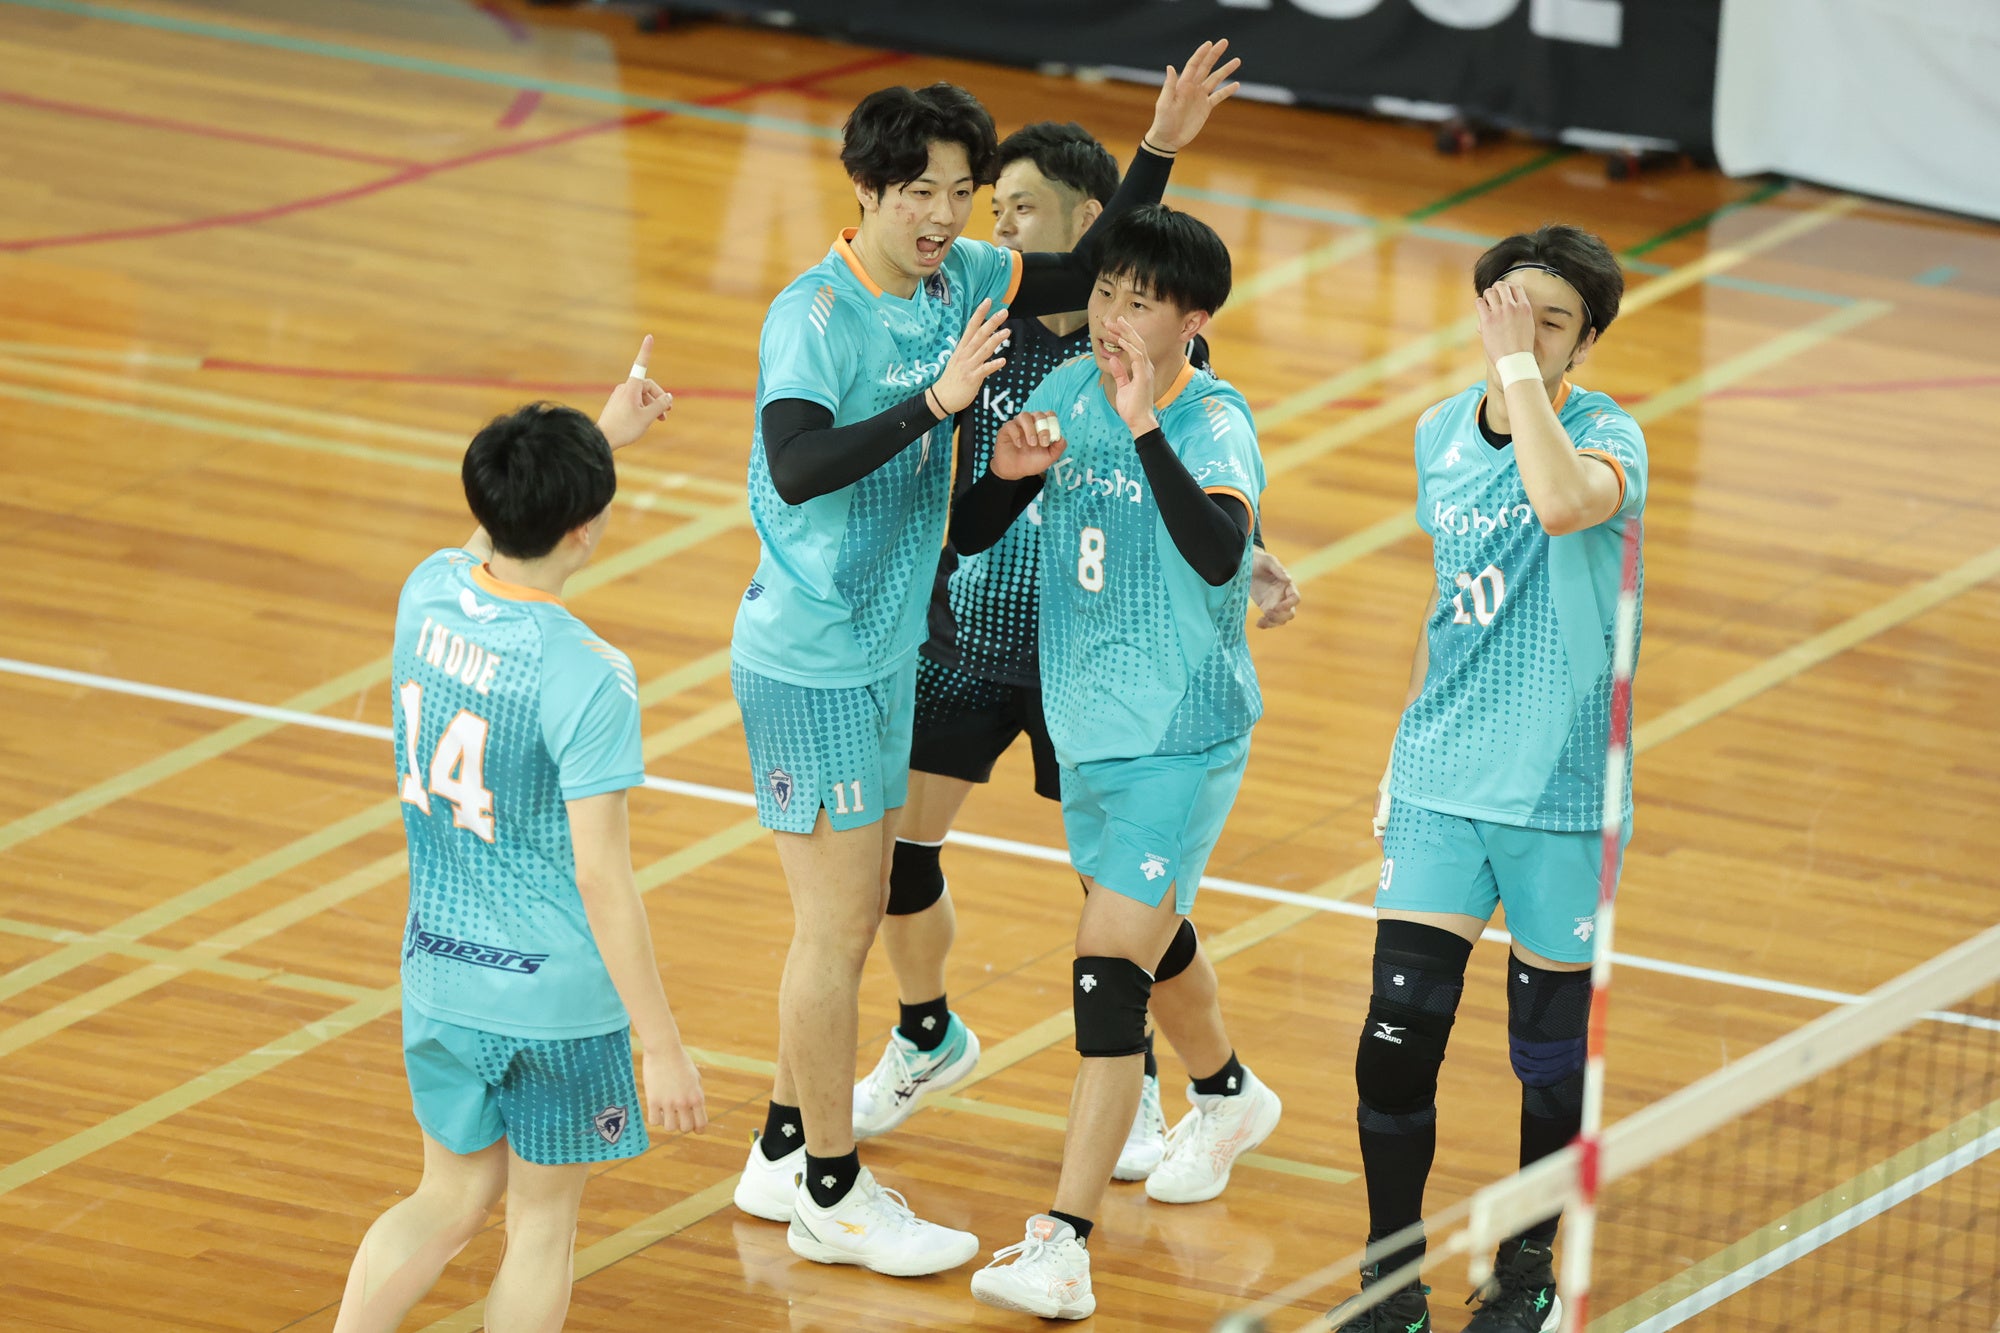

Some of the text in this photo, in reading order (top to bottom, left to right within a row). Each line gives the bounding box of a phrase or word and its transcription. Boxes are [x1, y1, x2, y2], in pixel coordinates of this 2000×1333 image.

[1434, 501, 1532, 538] Kubta
[1077, 525, 1106, 593] 8
[1452, 564, 1505, 627] 10
[414, 615, 501, 696] INOUE
[399, 677, 497, 845] 14
[833, 779, 865, 815] 11
